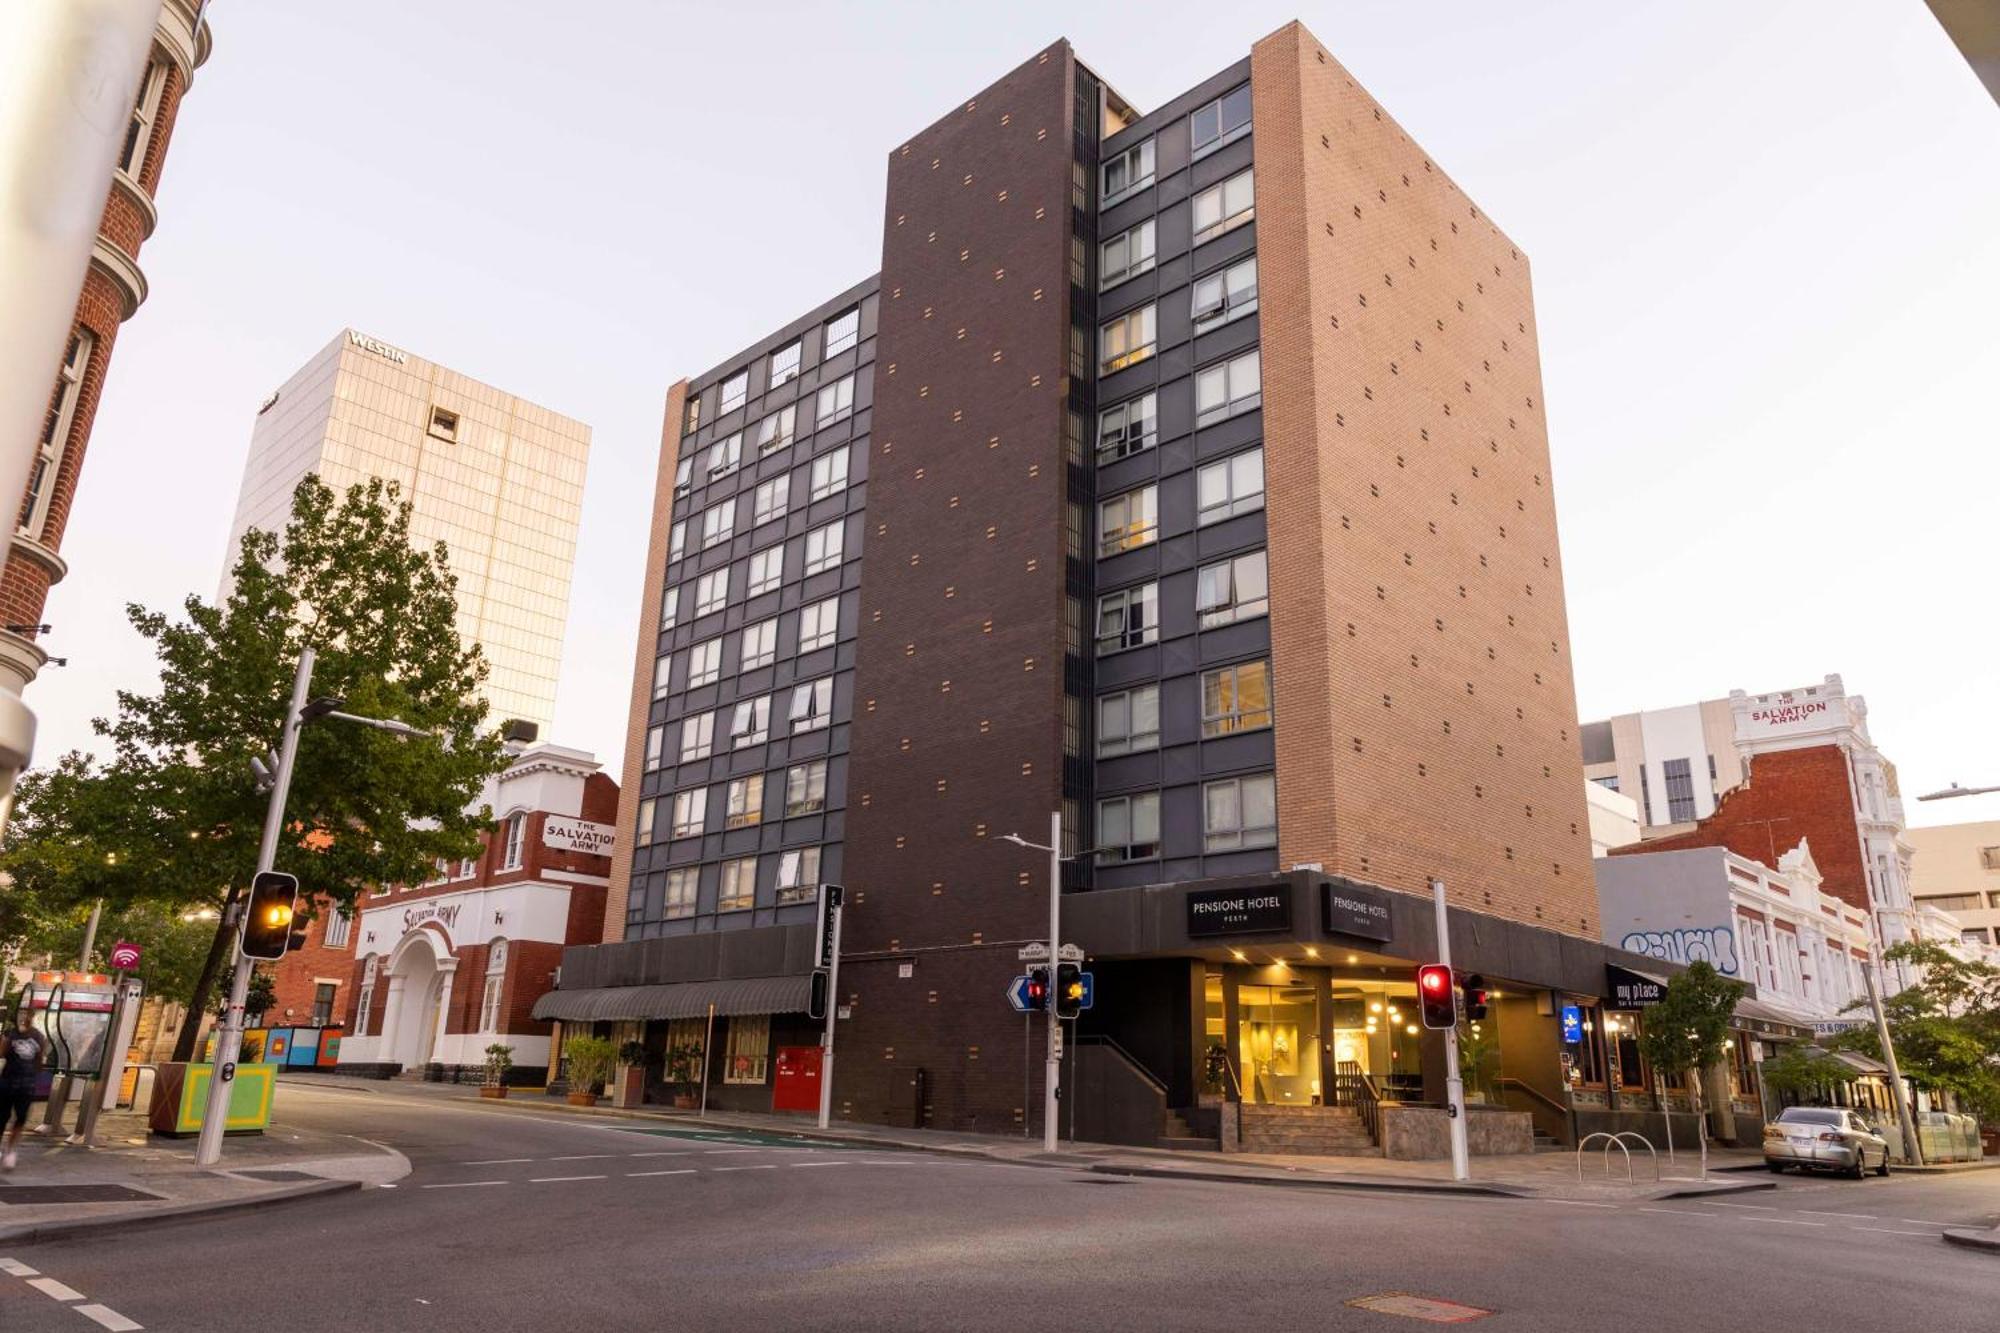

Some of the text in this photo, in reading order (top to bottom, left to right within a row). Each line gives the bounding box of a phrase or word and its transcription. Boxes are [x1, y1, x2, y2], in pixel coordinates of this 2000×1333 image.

[349, 331, 406, 364] WESTIN
[1752, 702, 1826, 721] SALVATION
[1770, 714, 1809, 725] ARMY
[577, 822, 596, 831] THE
[570, 840, 600, 852] ARMY
[1193, 896, 1280, 914] PENSIONE HOTEL
[1334, 896, 1388, 919] PENSIONE HOTEL
[437, 904, 461, 929] ARMY
[1617, 982, 1659, 1000] my place
